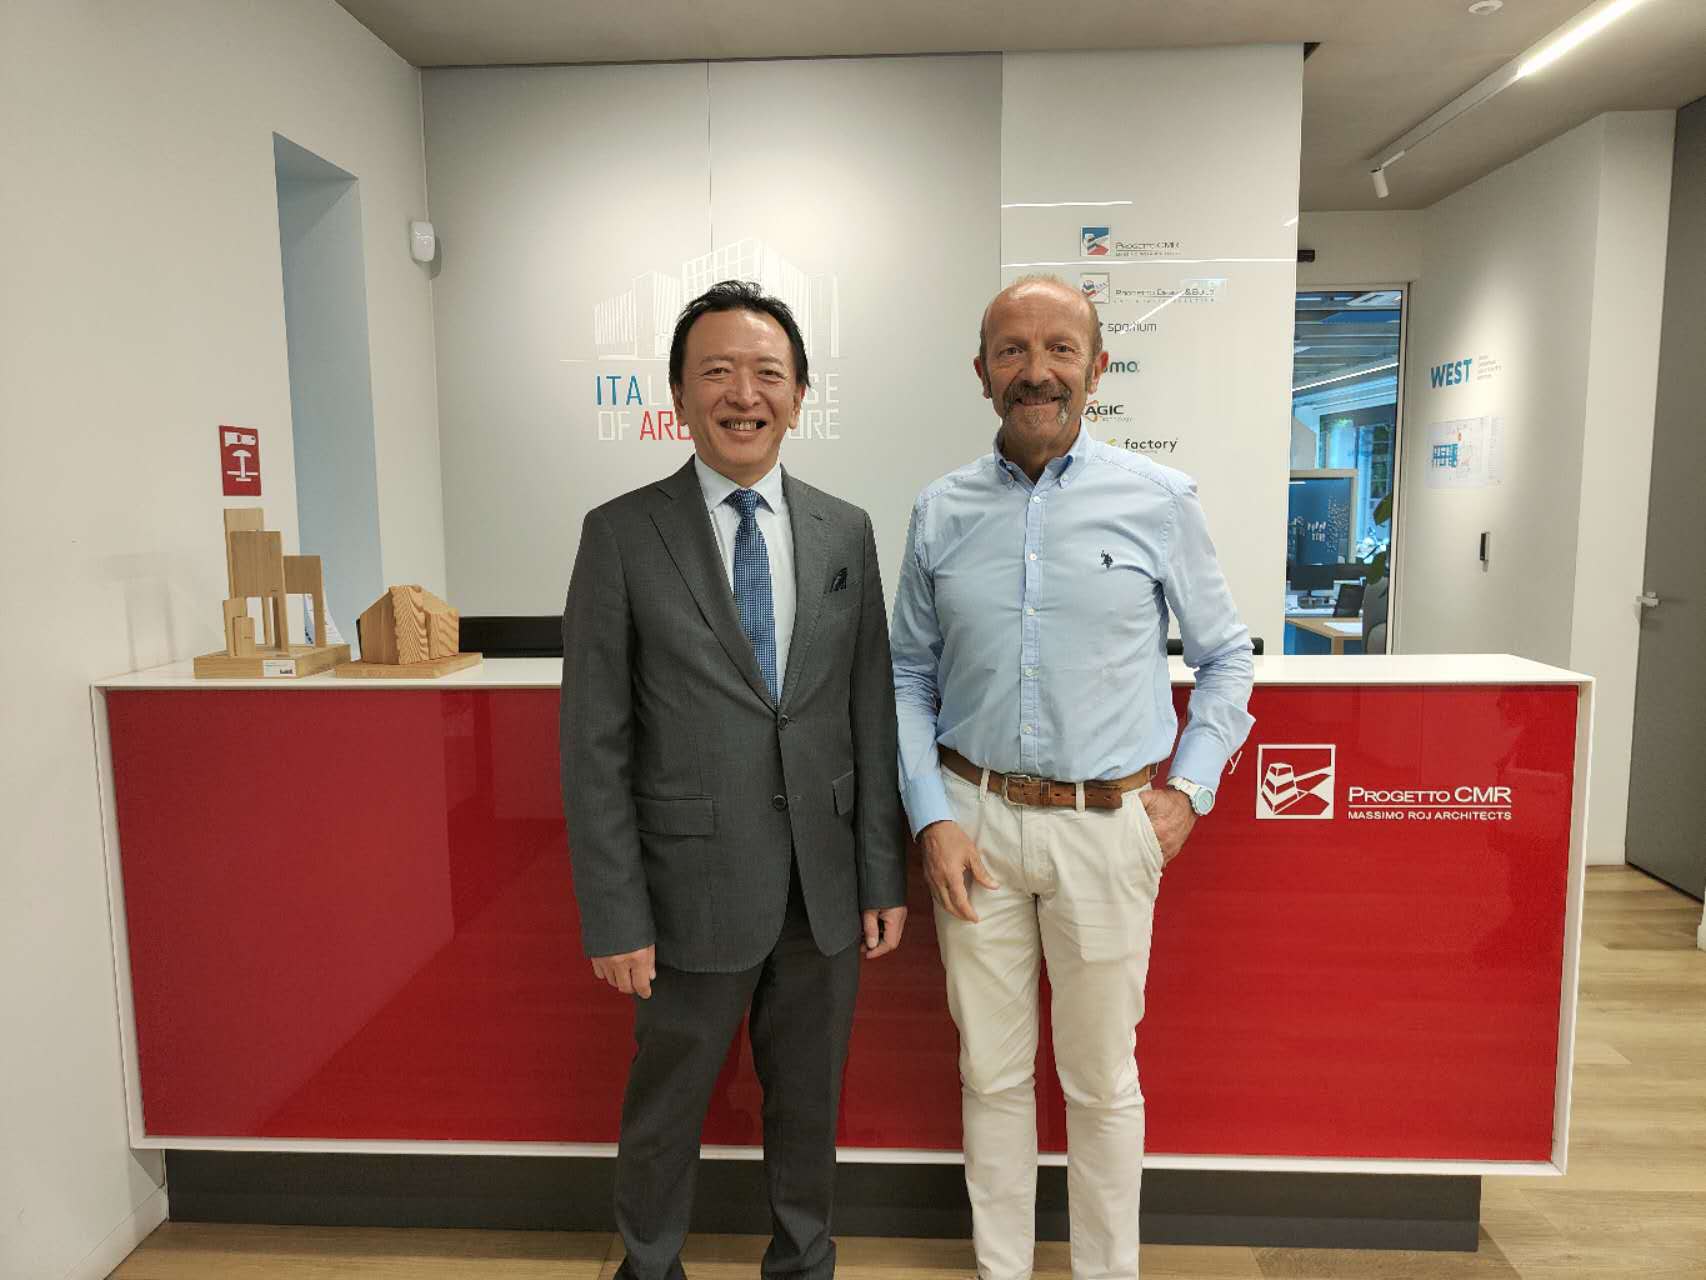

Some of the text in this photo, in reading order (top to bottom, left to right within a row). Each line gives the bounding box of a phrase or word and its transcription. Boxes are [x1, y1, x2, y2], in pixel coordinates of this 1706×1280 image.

[1103, 360, 1138, 373] mo
[1431, 358, 1472, 388] WEST
[598, 410, 631, 441] OF
[1125, 439, 1178, 454] factory
[1454, 786, 1512, 803] CMR
[1348, 810, 1512, 820] MASSIMO ROJ ARCHITECTS
